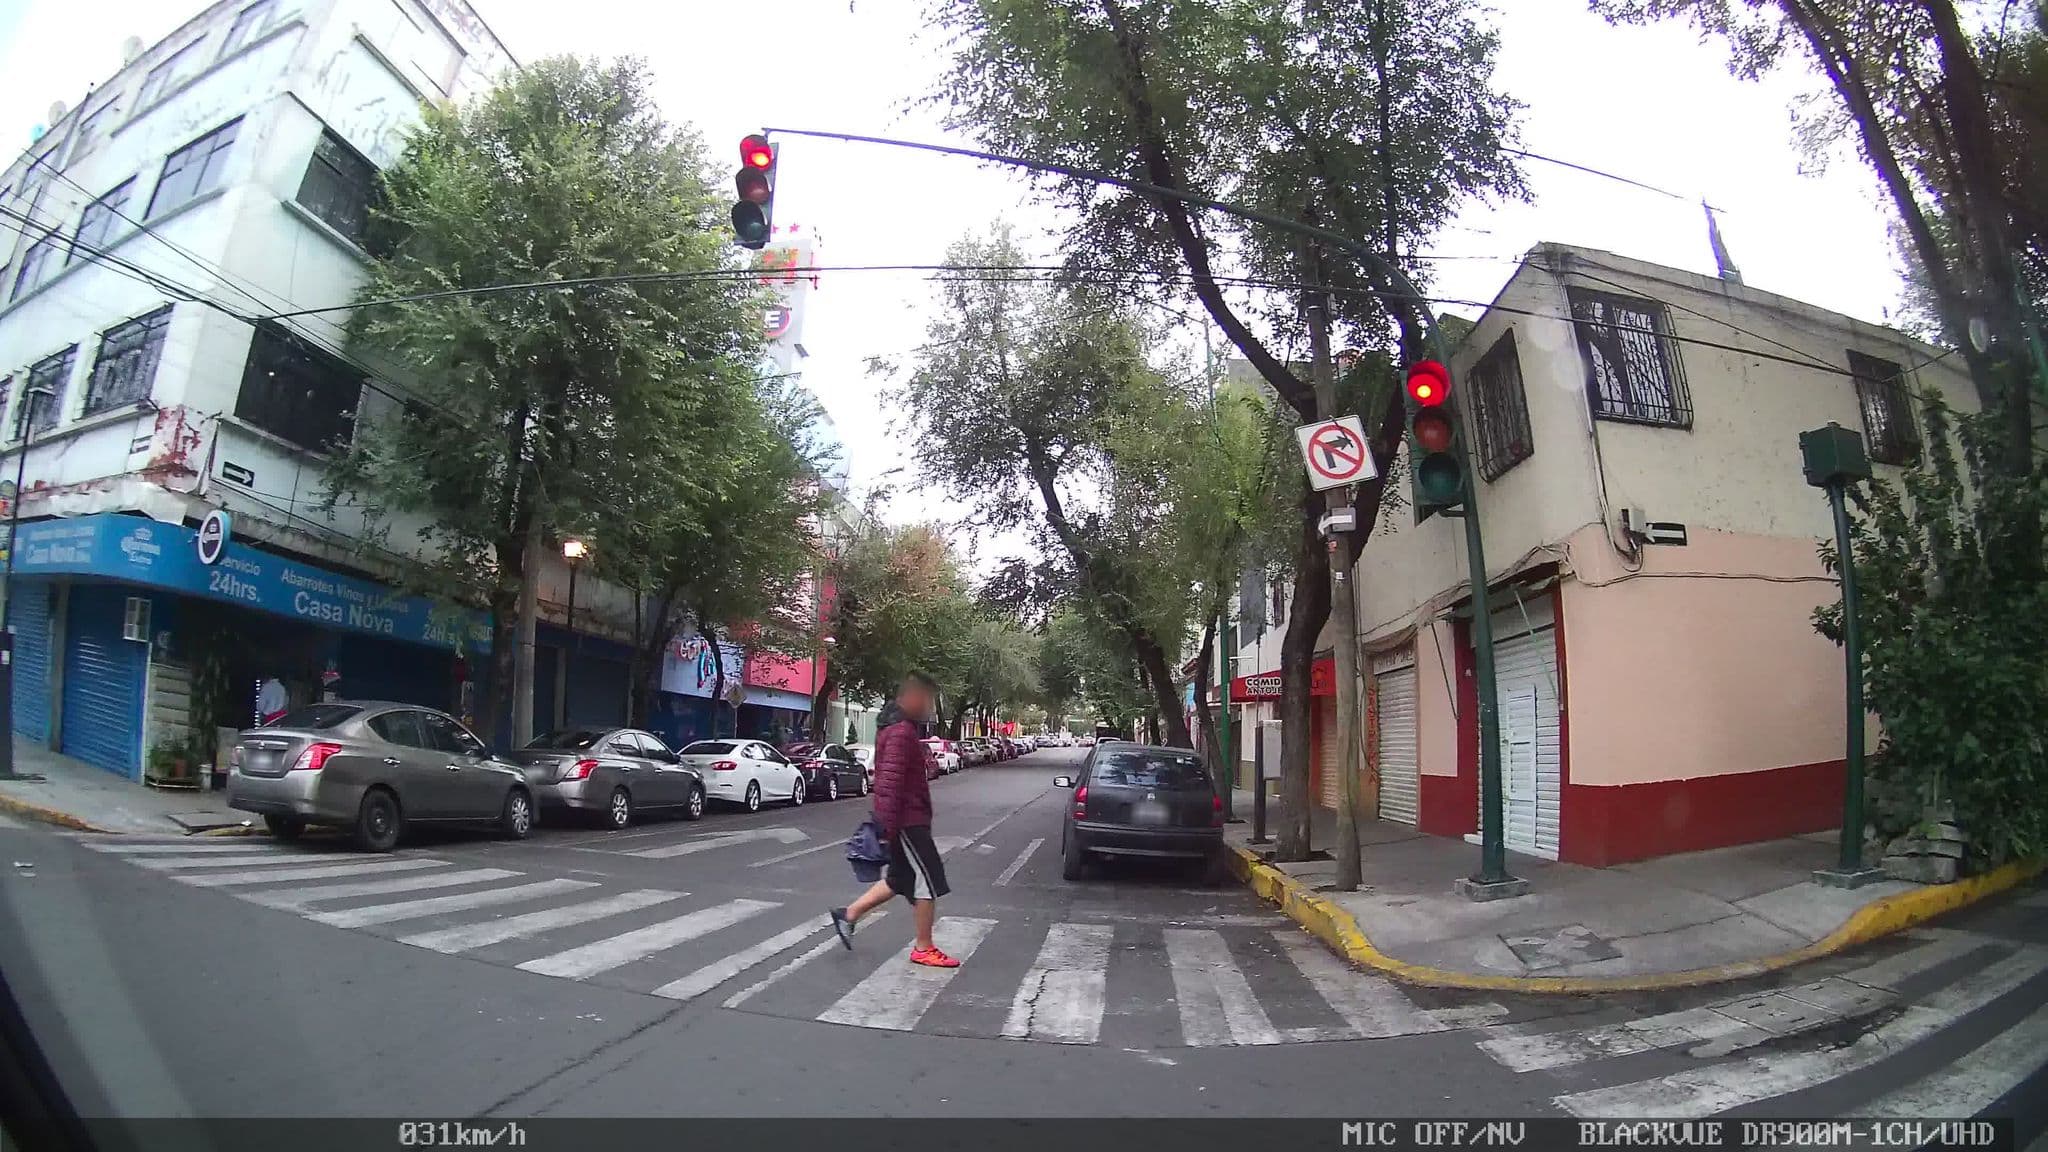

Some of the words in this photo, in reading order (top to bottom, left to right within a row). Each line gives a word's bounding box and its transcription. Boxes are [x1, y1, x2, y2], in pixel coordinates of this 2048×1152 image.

[209, 570, 261, 603] 24hrs.
[294, 590, 342, 622] Casa
[348, 603, 394, 633] Nova
